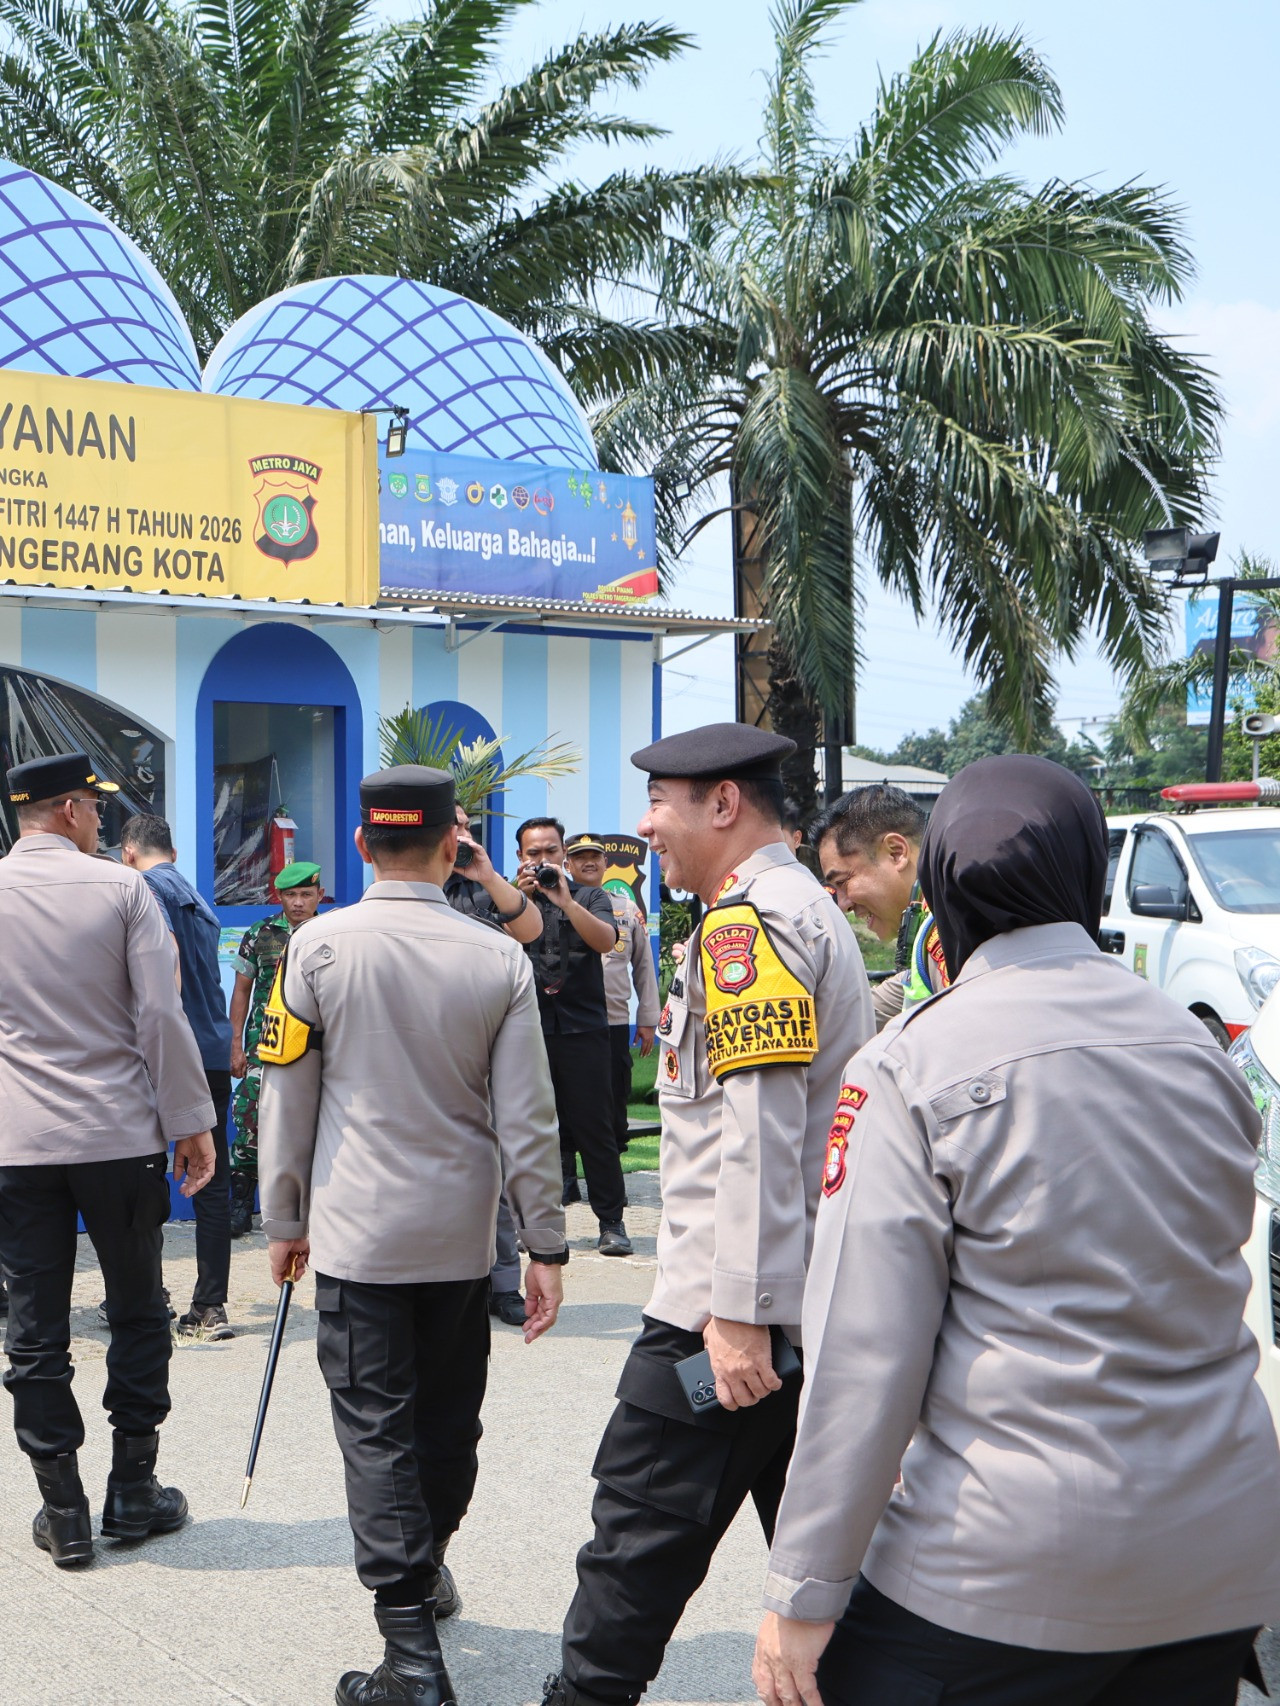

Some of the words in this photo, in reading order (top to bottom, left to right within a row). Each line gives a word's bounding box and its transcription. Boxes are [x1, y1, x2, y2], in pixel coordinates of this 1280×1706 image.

[252, 457, 290, 472] METRO
[292, 460, 318, 479] JAYA
[53, 502, 100, 532] 1447
[107, 506, 120, 533] H
[126, 508, 192, 539] TAHUN
[200, 514, 242, 543] 2026
[421, 520, 503, 561] Keluarga
[508, 528, 596, 567] Bahagia...!
[153, 547, 225, 583] KOTA
[373, 811, 419, 822] KAPOLRESTRO
[604, 843, 618, 851] RO
[619, 842, 640, 856] JAYA
[709, 929, 748, 946] POLDA
[704, 1000, 794, 1039] ASATGAS
[797, 999, 811, 1019] II
[706, 1019, 812, 1052] REVENTIF
[712, 1042, 752, 1062] KETUPAT
[754, 1038, 784, 1052] JAYA
[786, 1037, 814, 1048] 2026
